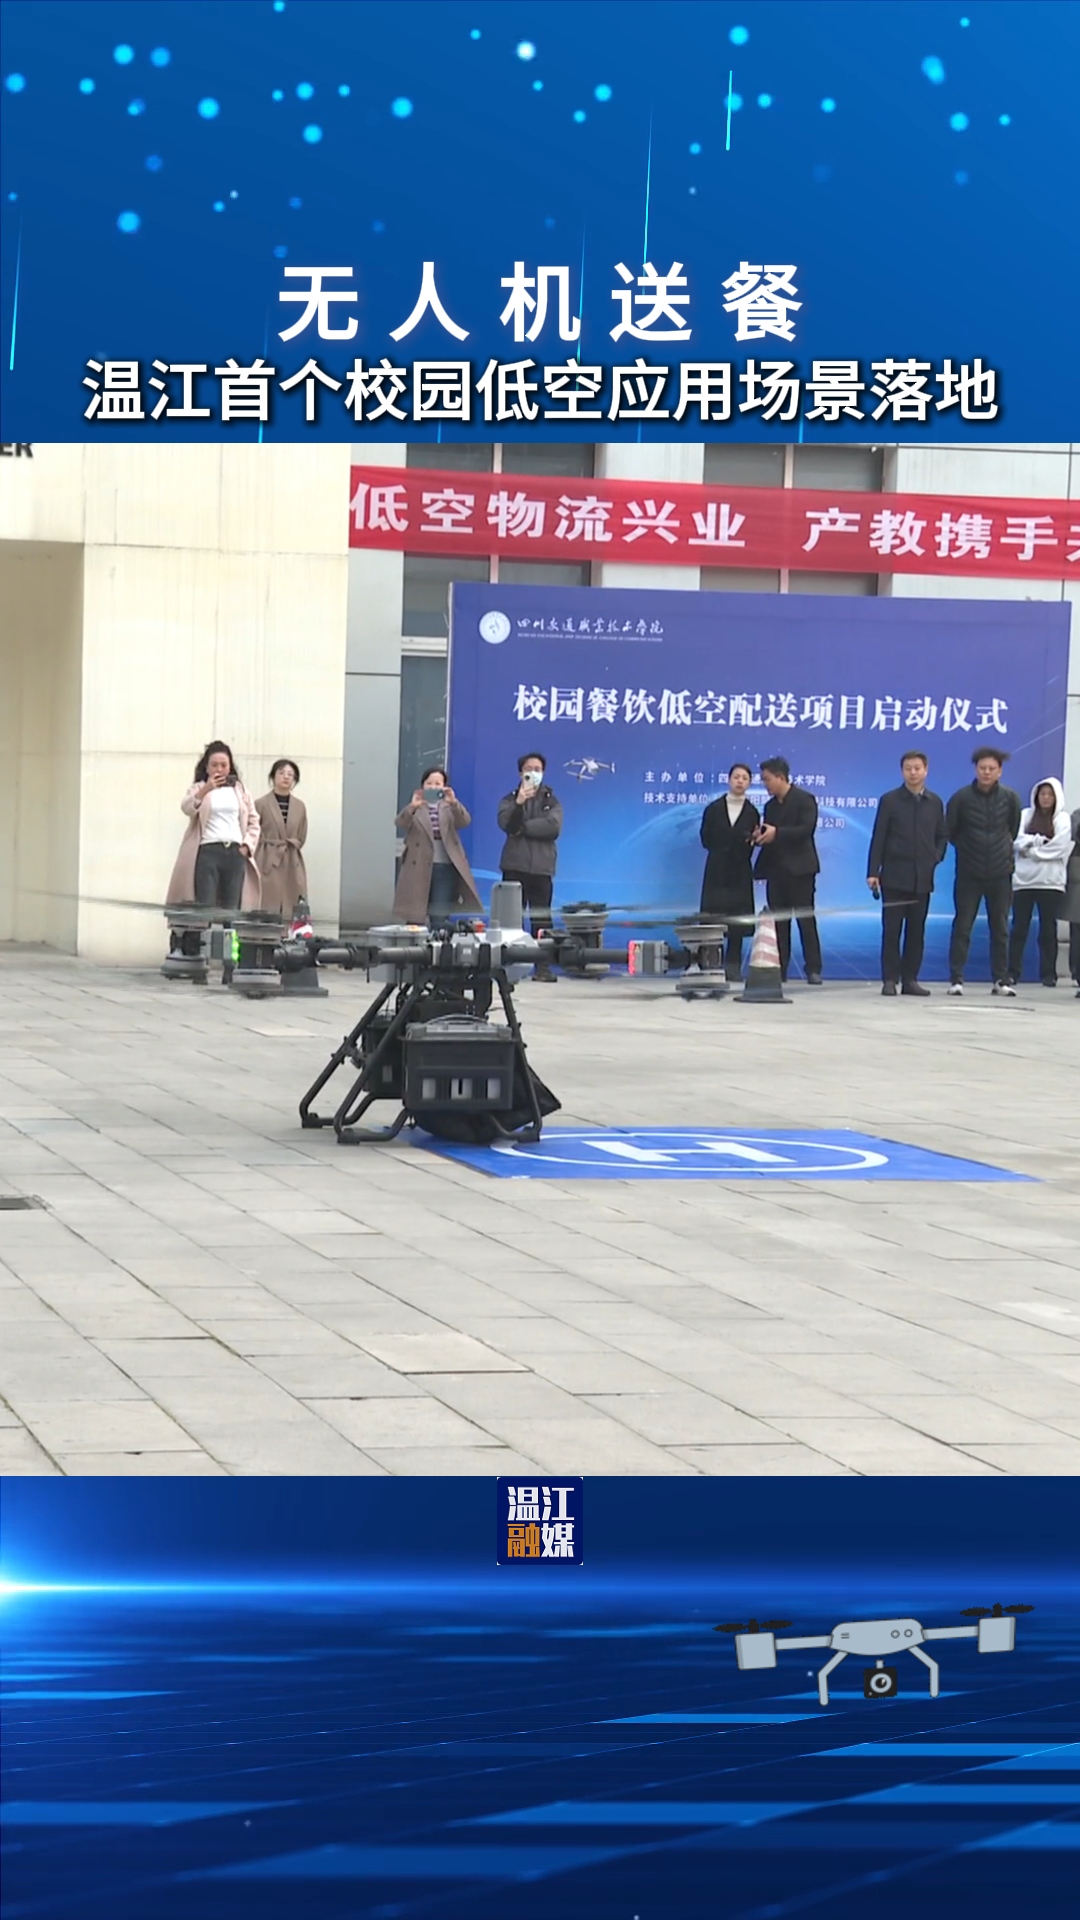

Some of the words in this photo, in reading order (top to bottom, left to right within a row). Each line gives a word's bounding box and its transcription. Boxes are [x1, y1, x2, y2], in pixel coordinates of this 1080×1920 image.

[350, 483, 745, 547] 低空物流兴业
[513, 684, 1009, 734] 校园餐饮低空配送项目启动仪式
[584, 1140, 797, 1164] H
